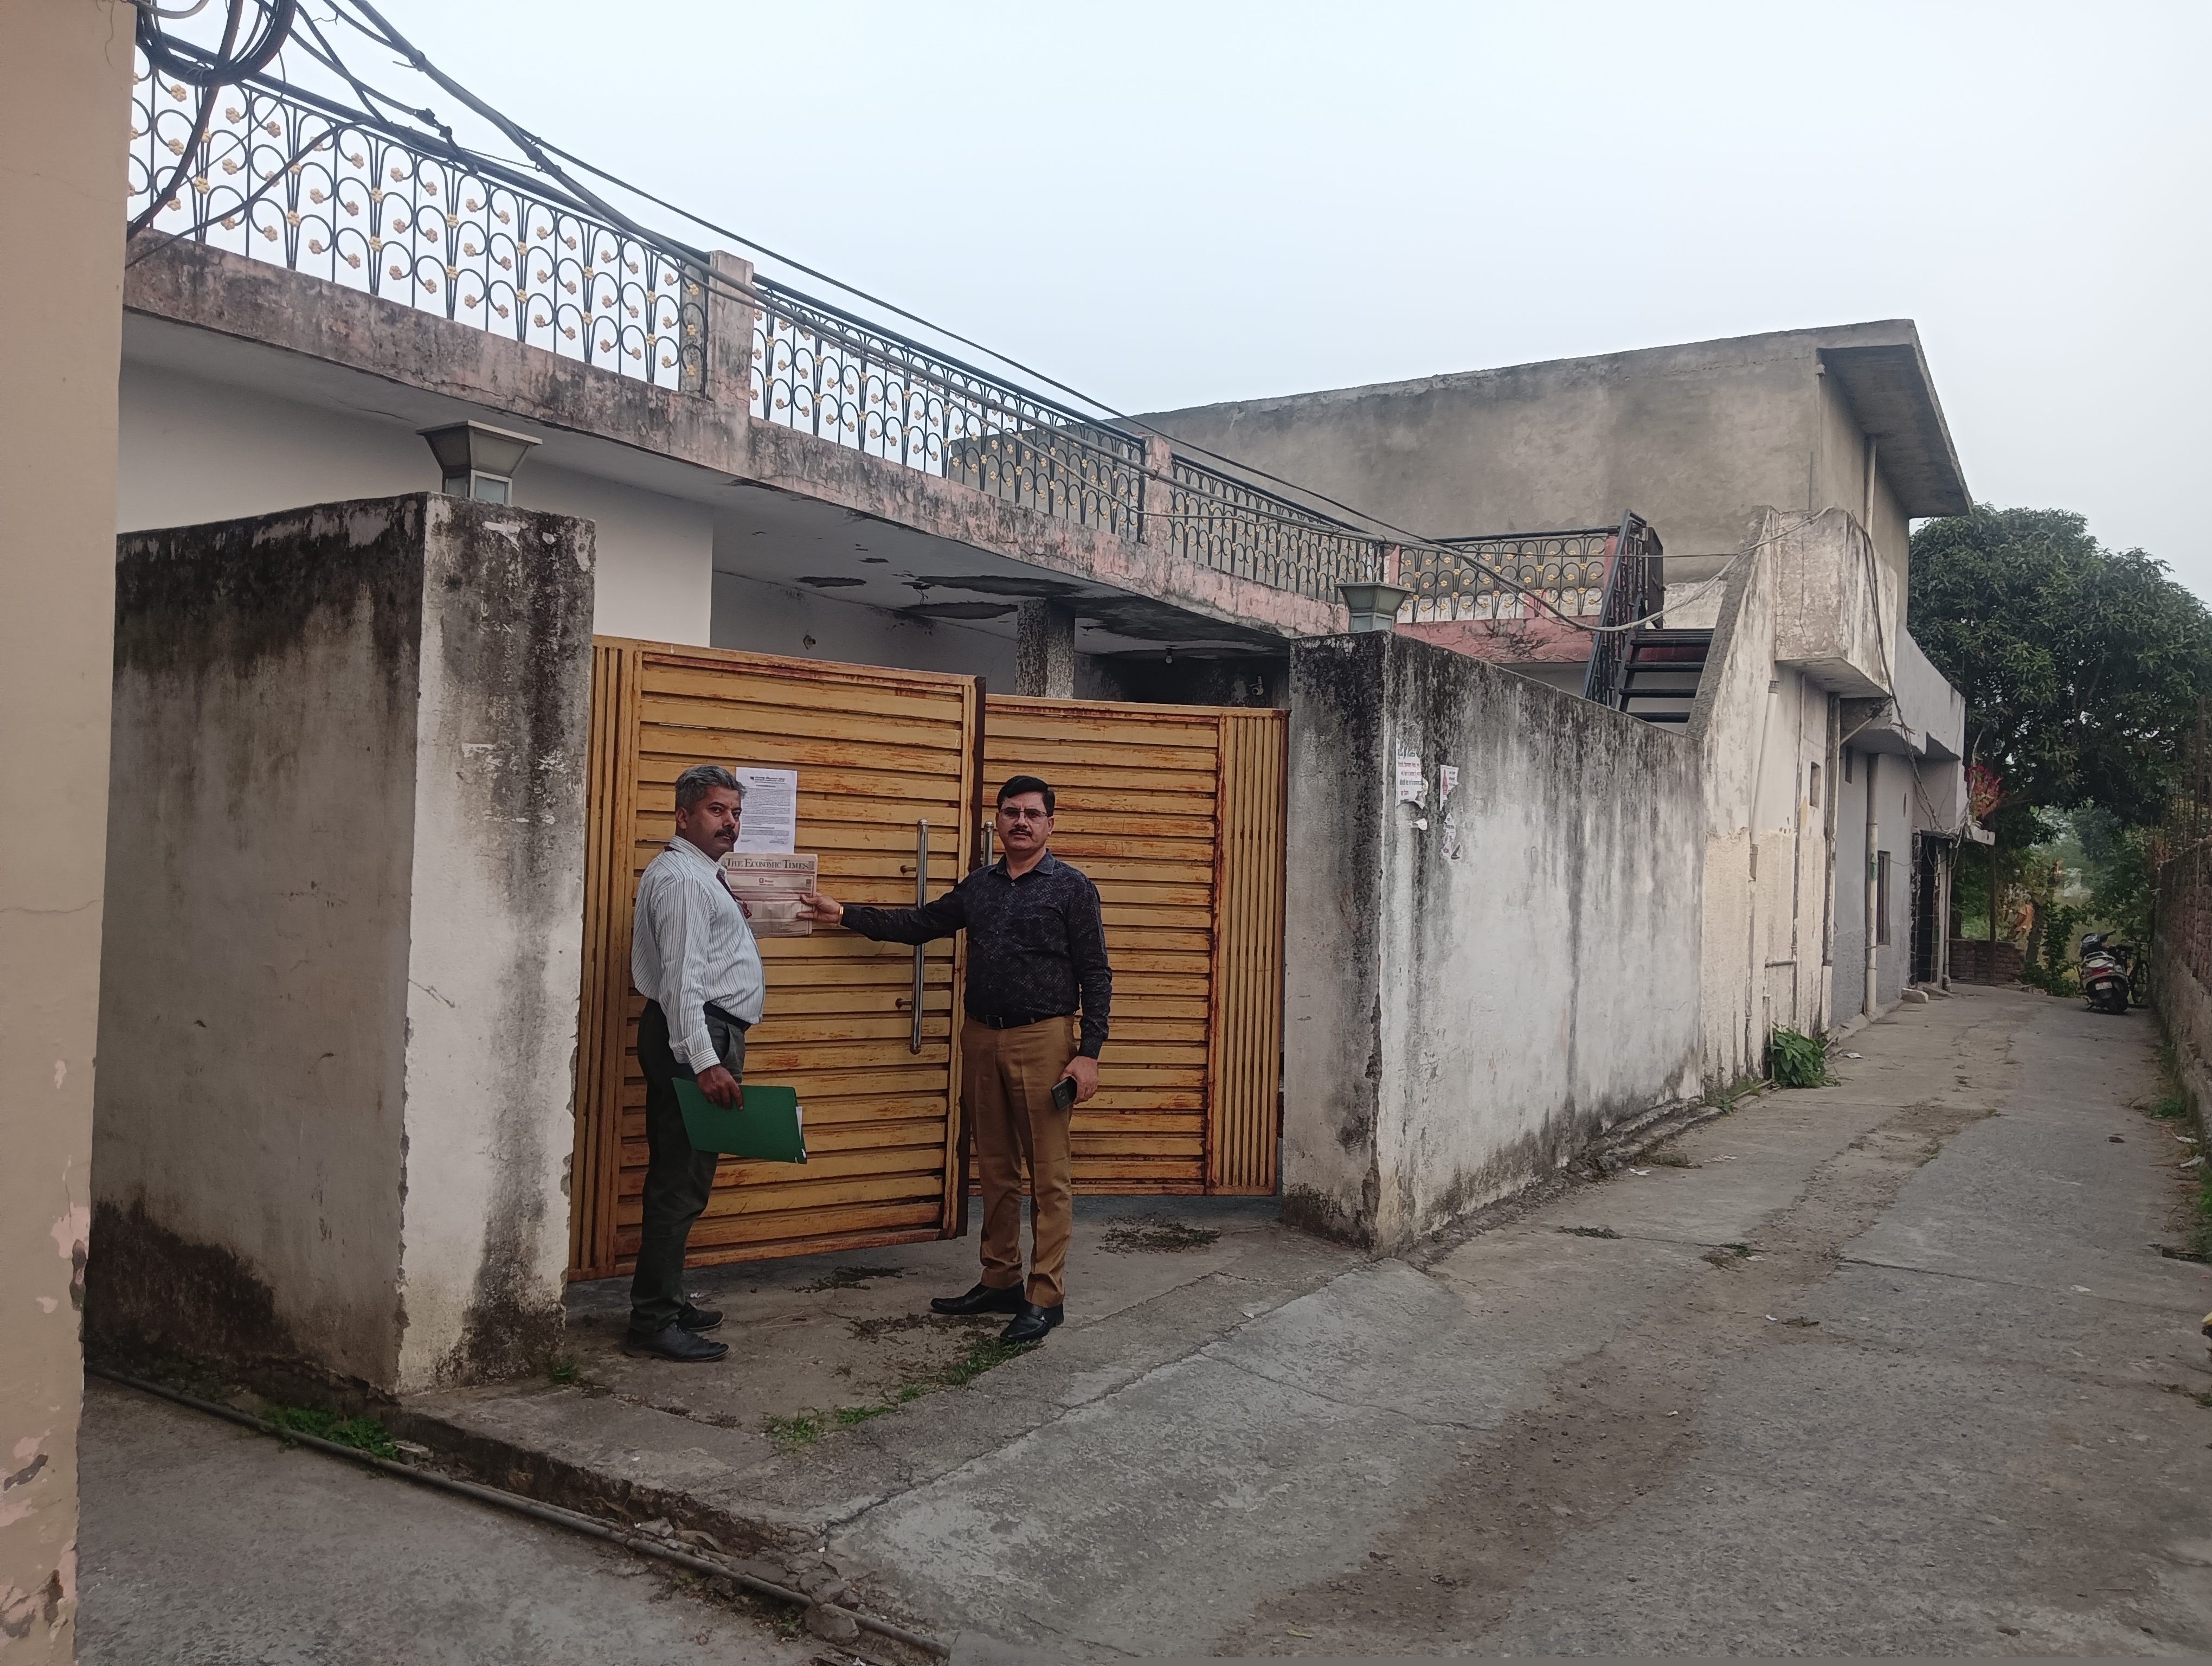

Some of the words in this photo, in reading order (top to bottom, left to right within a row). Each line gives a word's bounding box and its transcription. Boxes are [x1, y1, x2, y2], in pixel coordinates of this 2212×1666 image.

[726, 858, 743, 867] THE
[745, 858, 781, 868] ECONOMIC
[782, 860, 808, 869] TIMES
